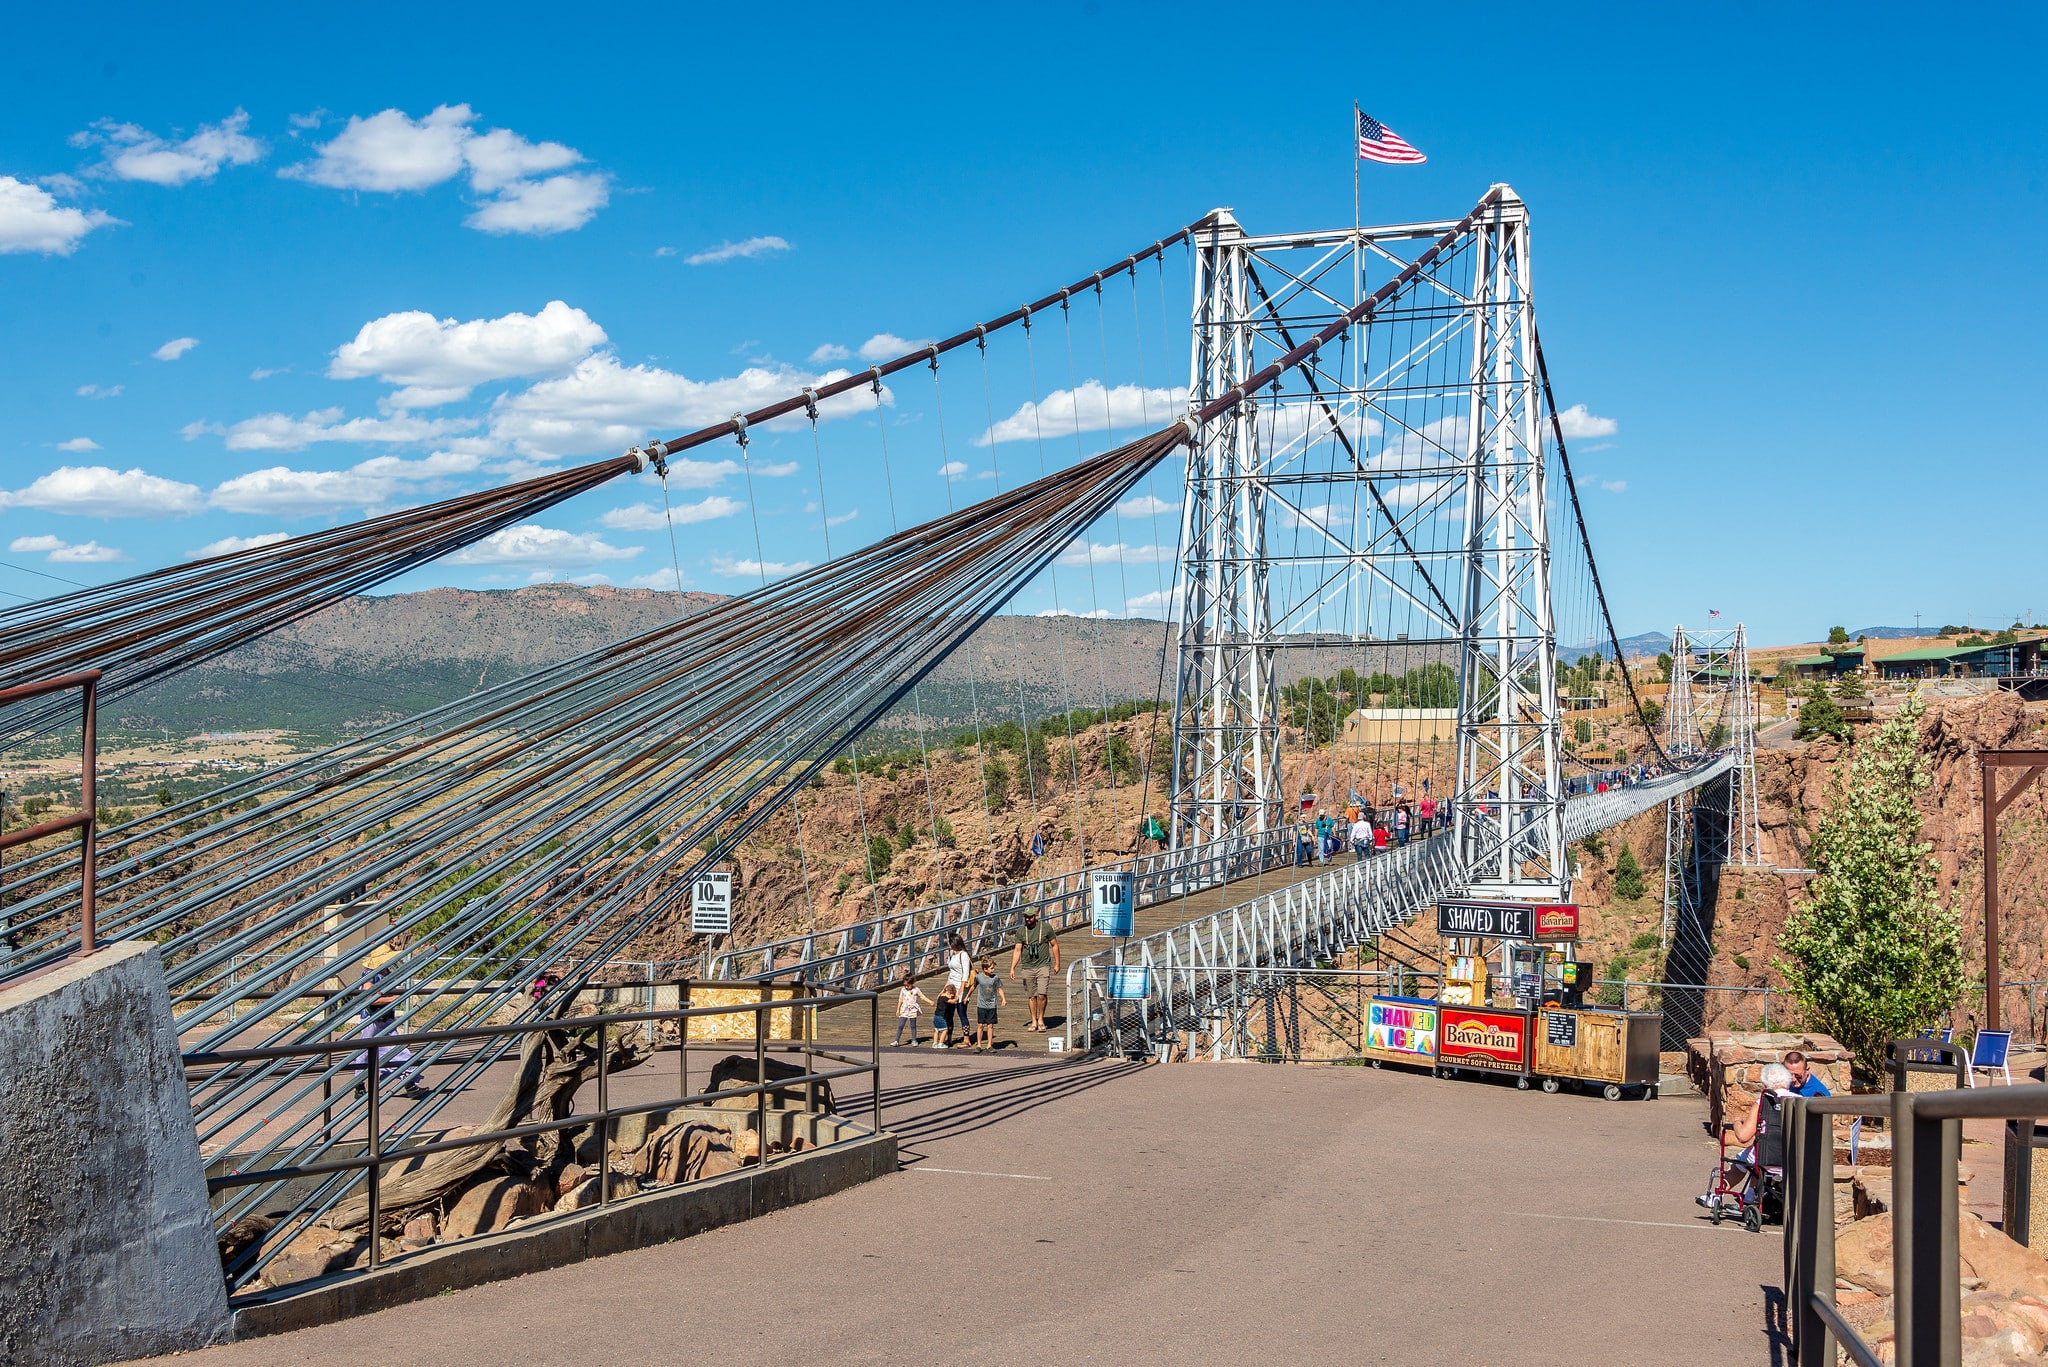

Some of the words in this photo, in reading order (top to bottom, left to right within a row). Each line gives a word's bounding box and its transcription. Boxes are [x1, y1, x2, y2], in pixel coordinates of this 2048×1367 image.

[698, 882, 714, 901] 10
[1099, 884, 1121, 904] 10
[1447, 907, 1493, 932] SHAVED
[1500, 910, 1522, 934] ICE
[1541, 915, 1573, 926] Bavarian
[1371, 1005, 1435, 1031] SHAVED
[1387, 1028, 1415, 1050] ICE
[1447, 1026, 1516, 1048] Bavarian
[1440, 1055, 1470, 1066] GOURMET
[1470, 1059, 1488, 1068] SOFT
[1488, 1061, 1522, 1072] PRETZELS
